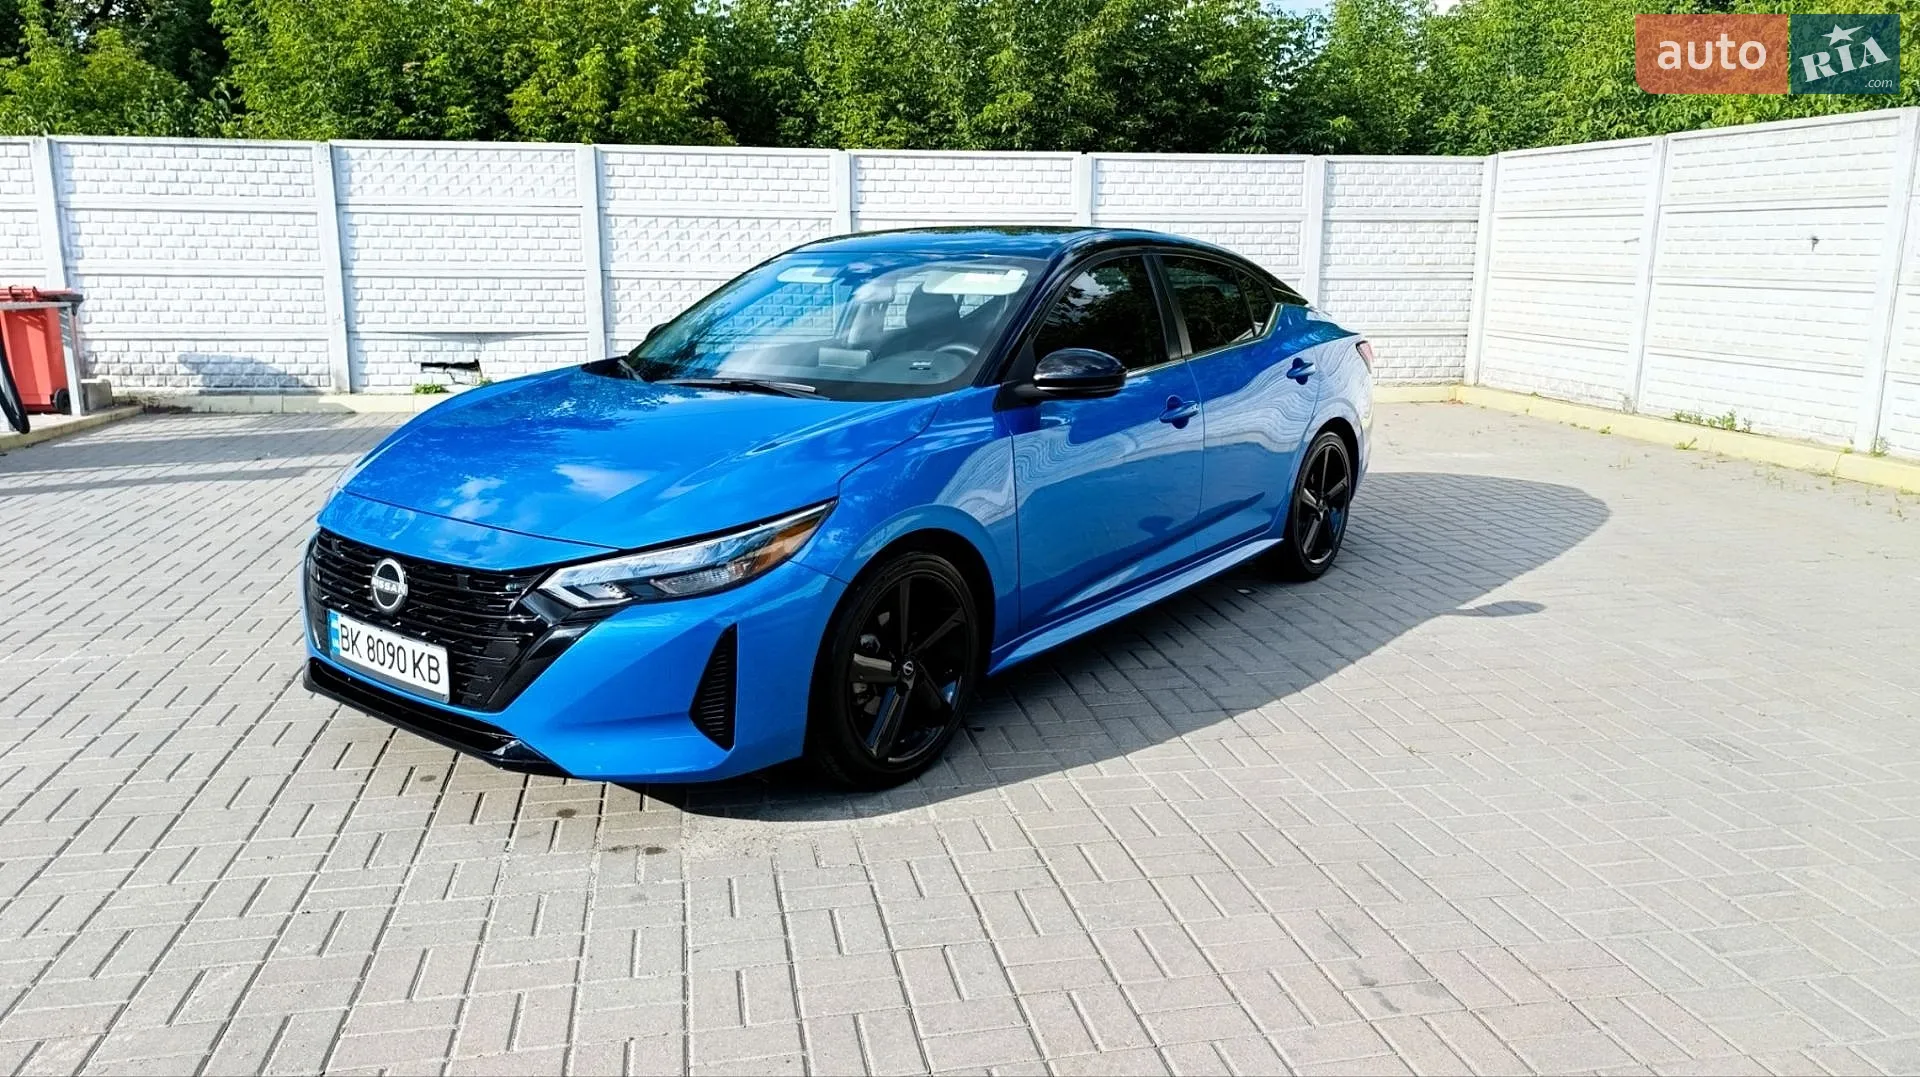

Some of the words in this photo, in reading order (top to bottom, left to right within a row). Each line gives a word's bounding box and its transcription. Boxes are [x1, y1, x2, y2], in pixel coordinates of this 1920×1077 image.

[372, 576, 408, 596] NISSAN
[340, 623, 362, 659] BK
[366, 634, 407, 674] 8090
[411, 648, 441, 685] KB
